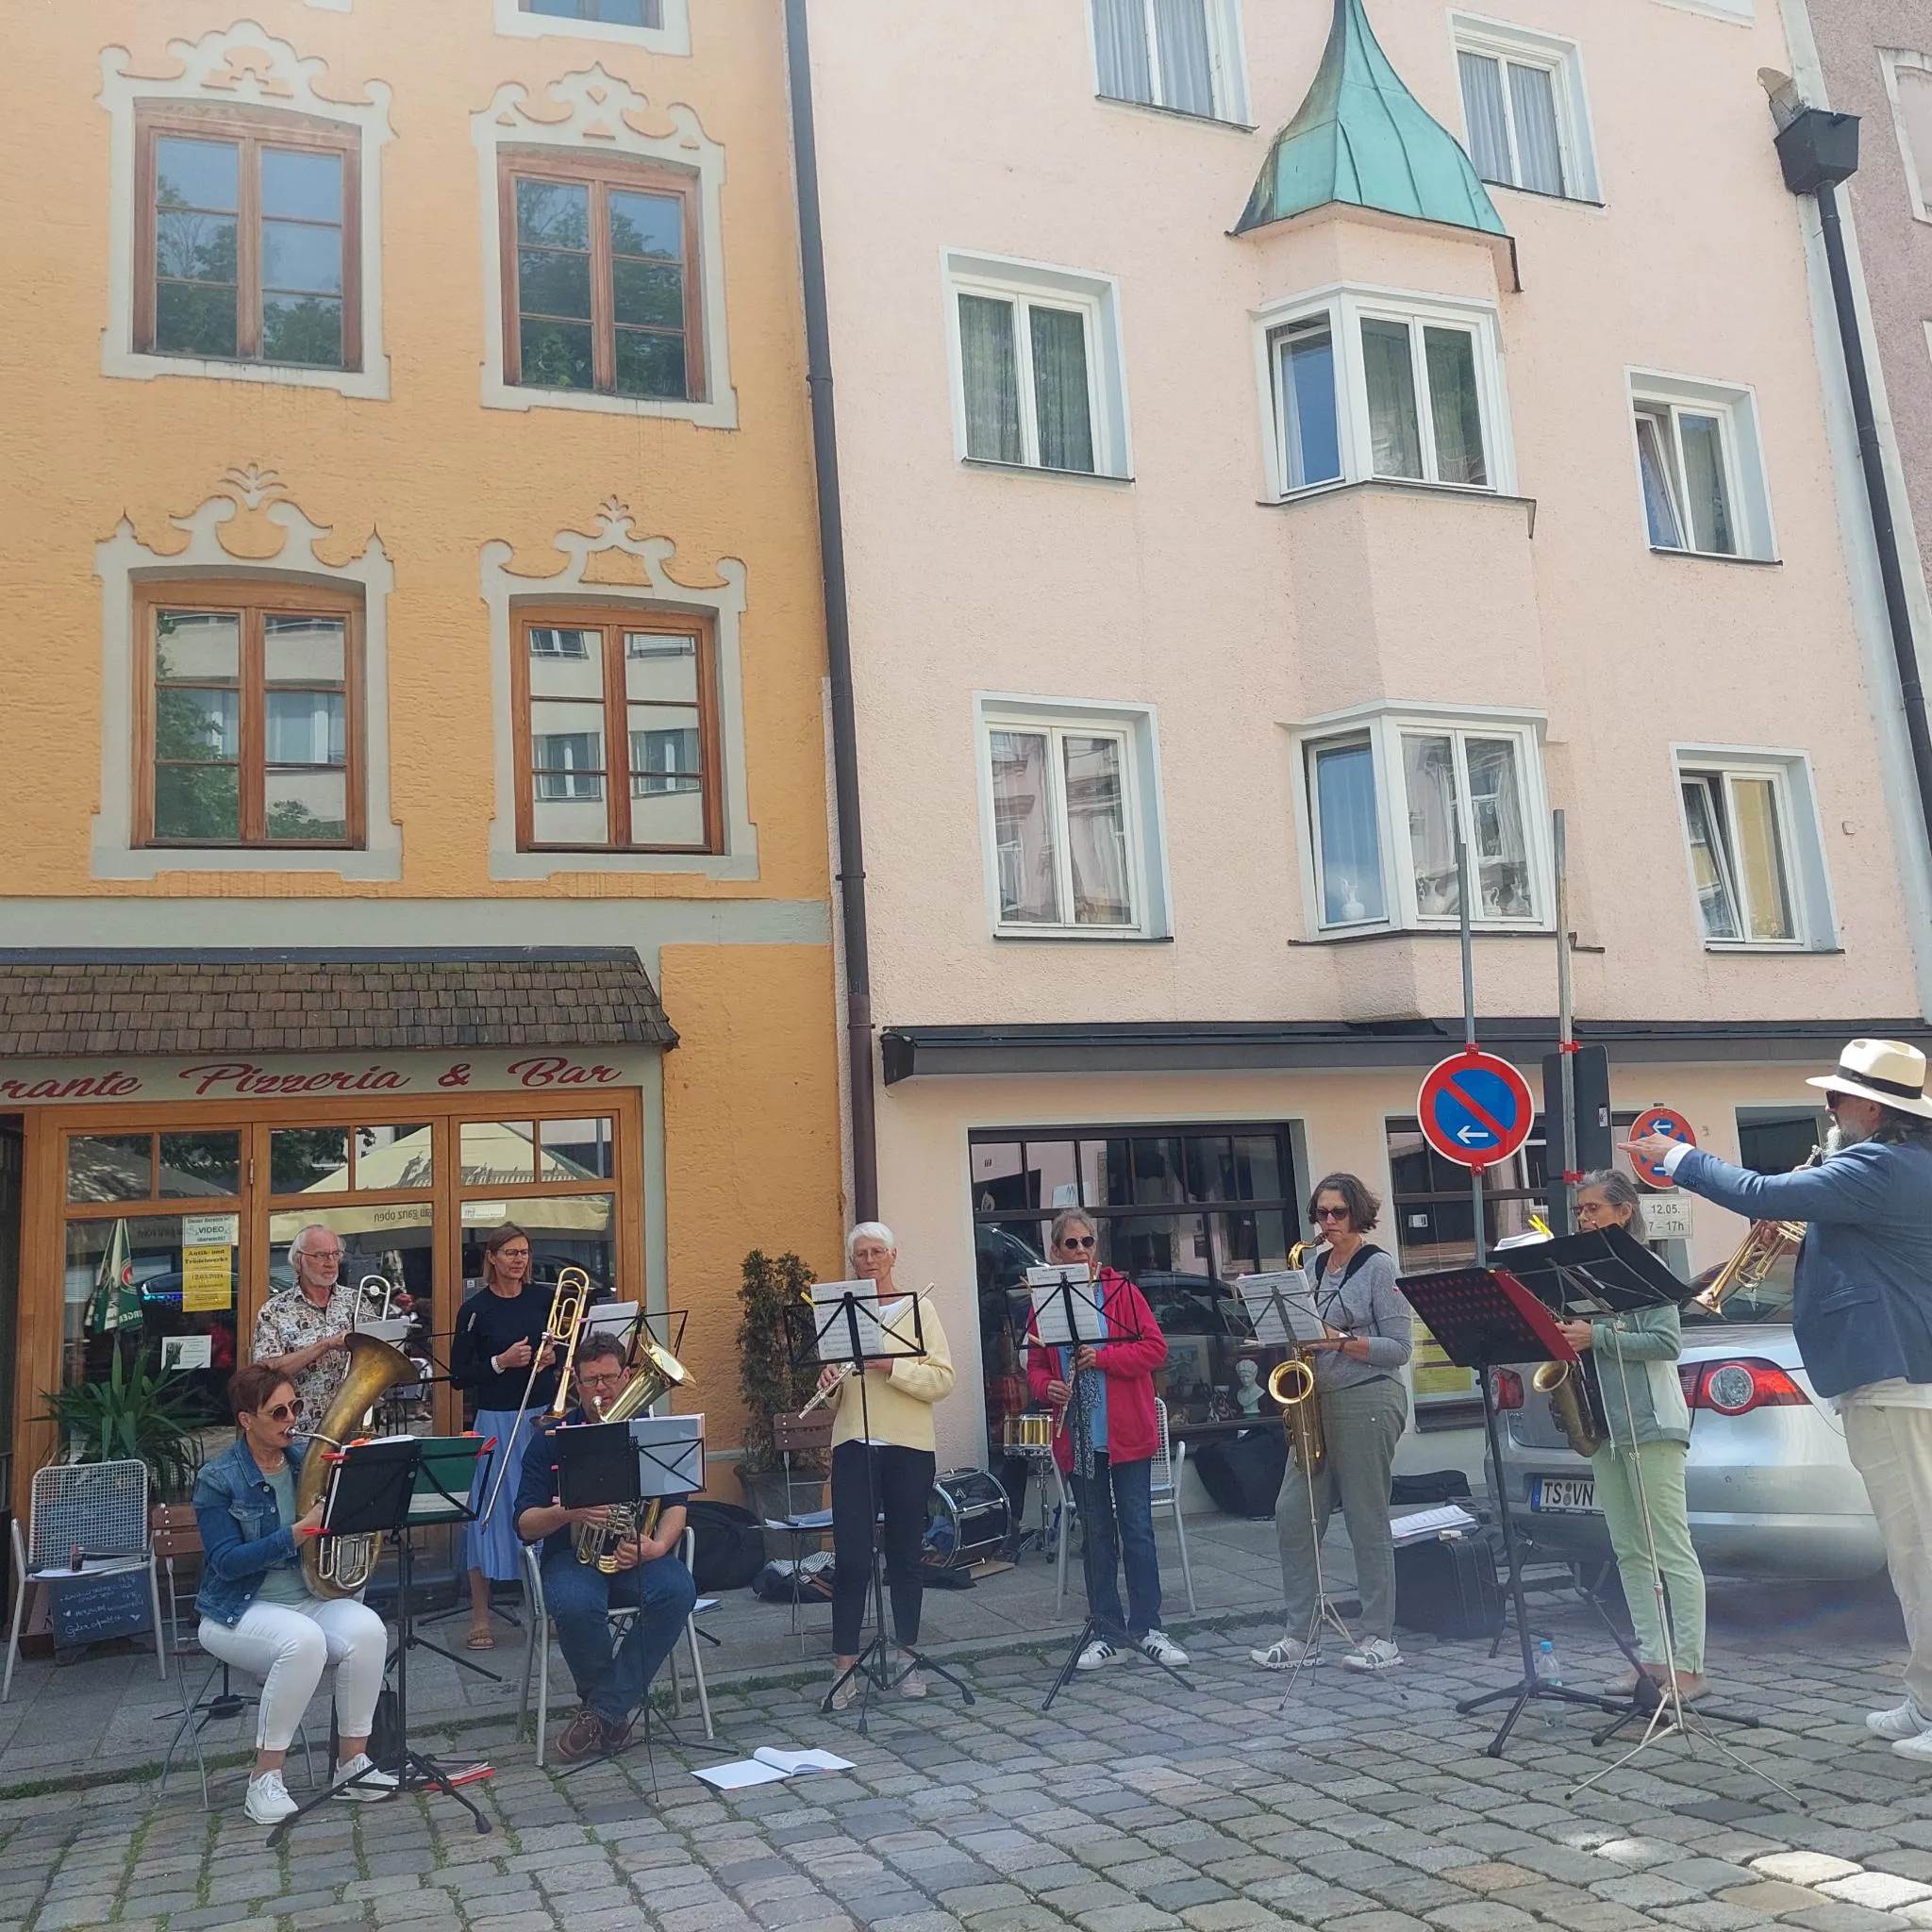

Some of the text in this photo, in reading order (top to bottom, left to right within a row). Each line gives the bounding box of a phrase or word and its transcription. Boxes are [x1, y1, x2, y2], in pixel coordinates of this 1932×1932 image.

[178, 1062, 411, 1095] Pizzeria
[437, 1063, 471, 1087] &
[507, 1057, 624, 1086] Bar
[1651, 1204, 1680, 1214] 12.05.
[198, 1225, 225, 1235] VIDEO
[1648, 1222, 1655, 1232] 7
[1666, 1221, 1685, 1231] 17h
[1544, 1481, 1563, 1505] TS
[1573, 1483, 1594, 1507] VN
